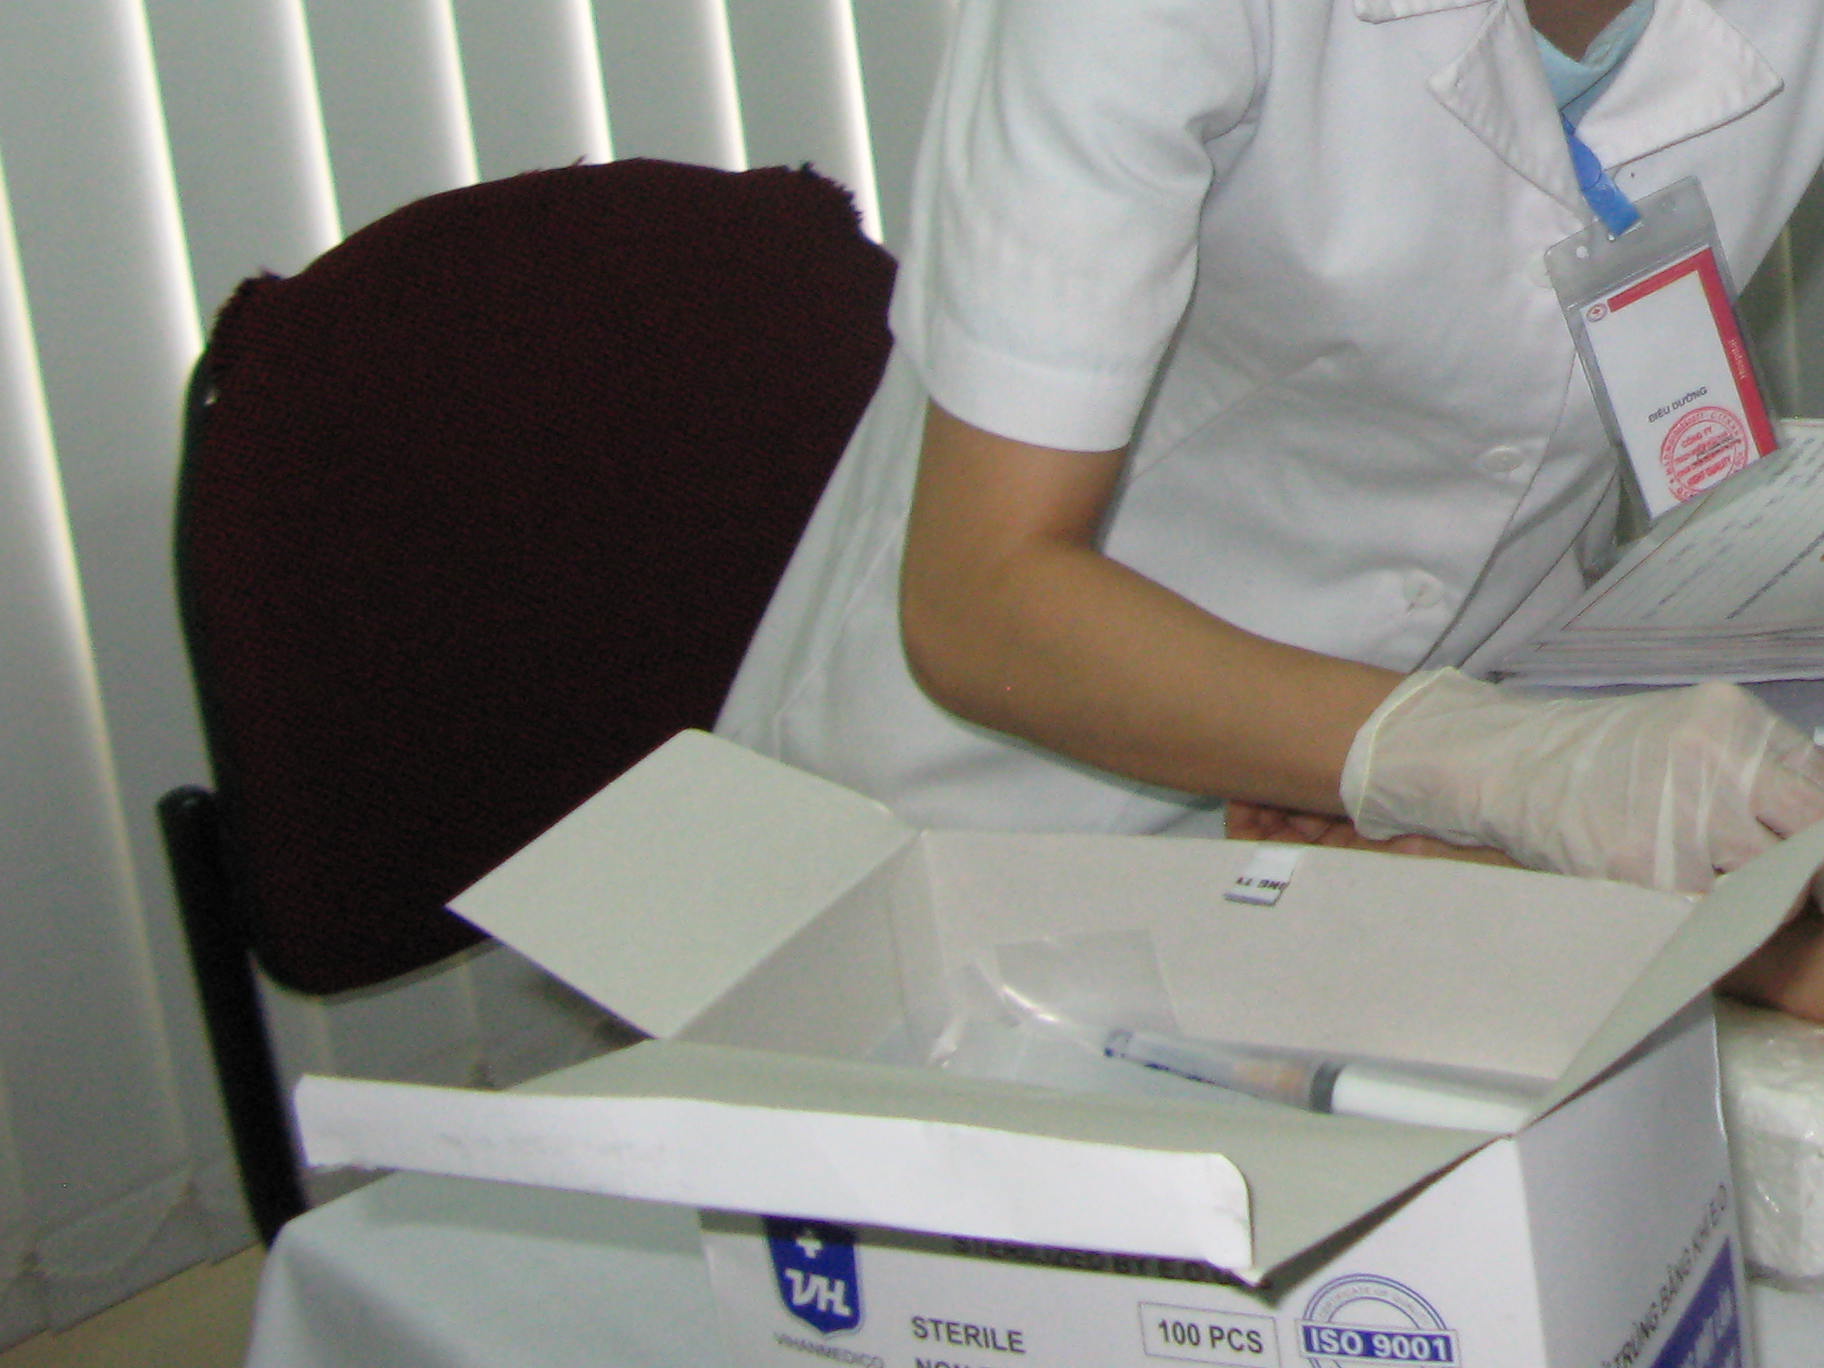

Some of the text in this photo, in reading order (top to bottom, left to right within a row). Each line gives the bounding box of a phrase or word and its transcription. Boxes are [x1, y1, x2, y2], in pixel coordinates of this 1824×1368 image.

[911, 1315, 1027, 1354] STERILE
[1158, 1318, 1264, 1354] 100 PCS
[1310, 1328, 1447, 1361] ISO 9001
